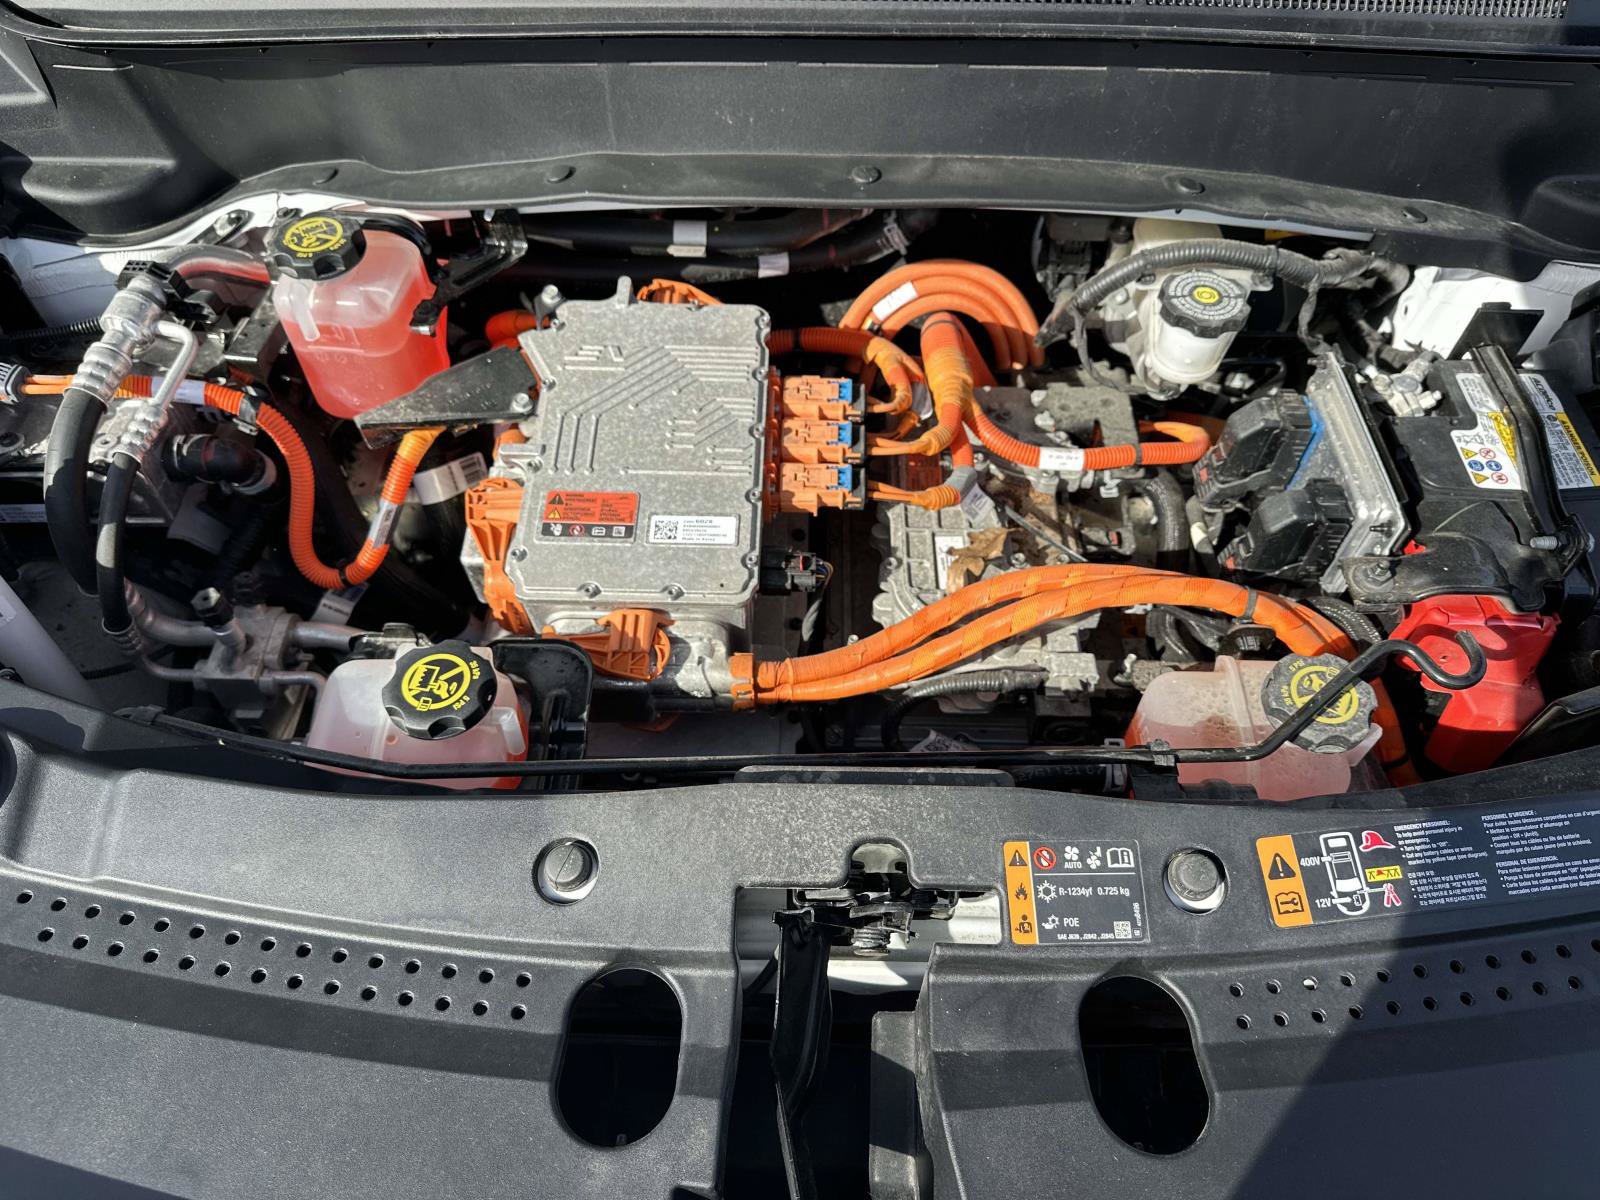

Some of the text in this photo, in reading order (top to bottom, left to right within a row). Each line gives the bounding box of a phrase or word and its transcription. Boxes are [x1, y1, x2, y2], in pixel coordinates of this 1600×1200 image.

[452, 700, 465, 710] PSI
[1300, 856, 1320, 867] 400V
[1058, 886, 1130, 898] R-1234yf 0.725 kg
[1315, 898, 1330, 908] 12V
[1064, 918, 1080, 927] POE
